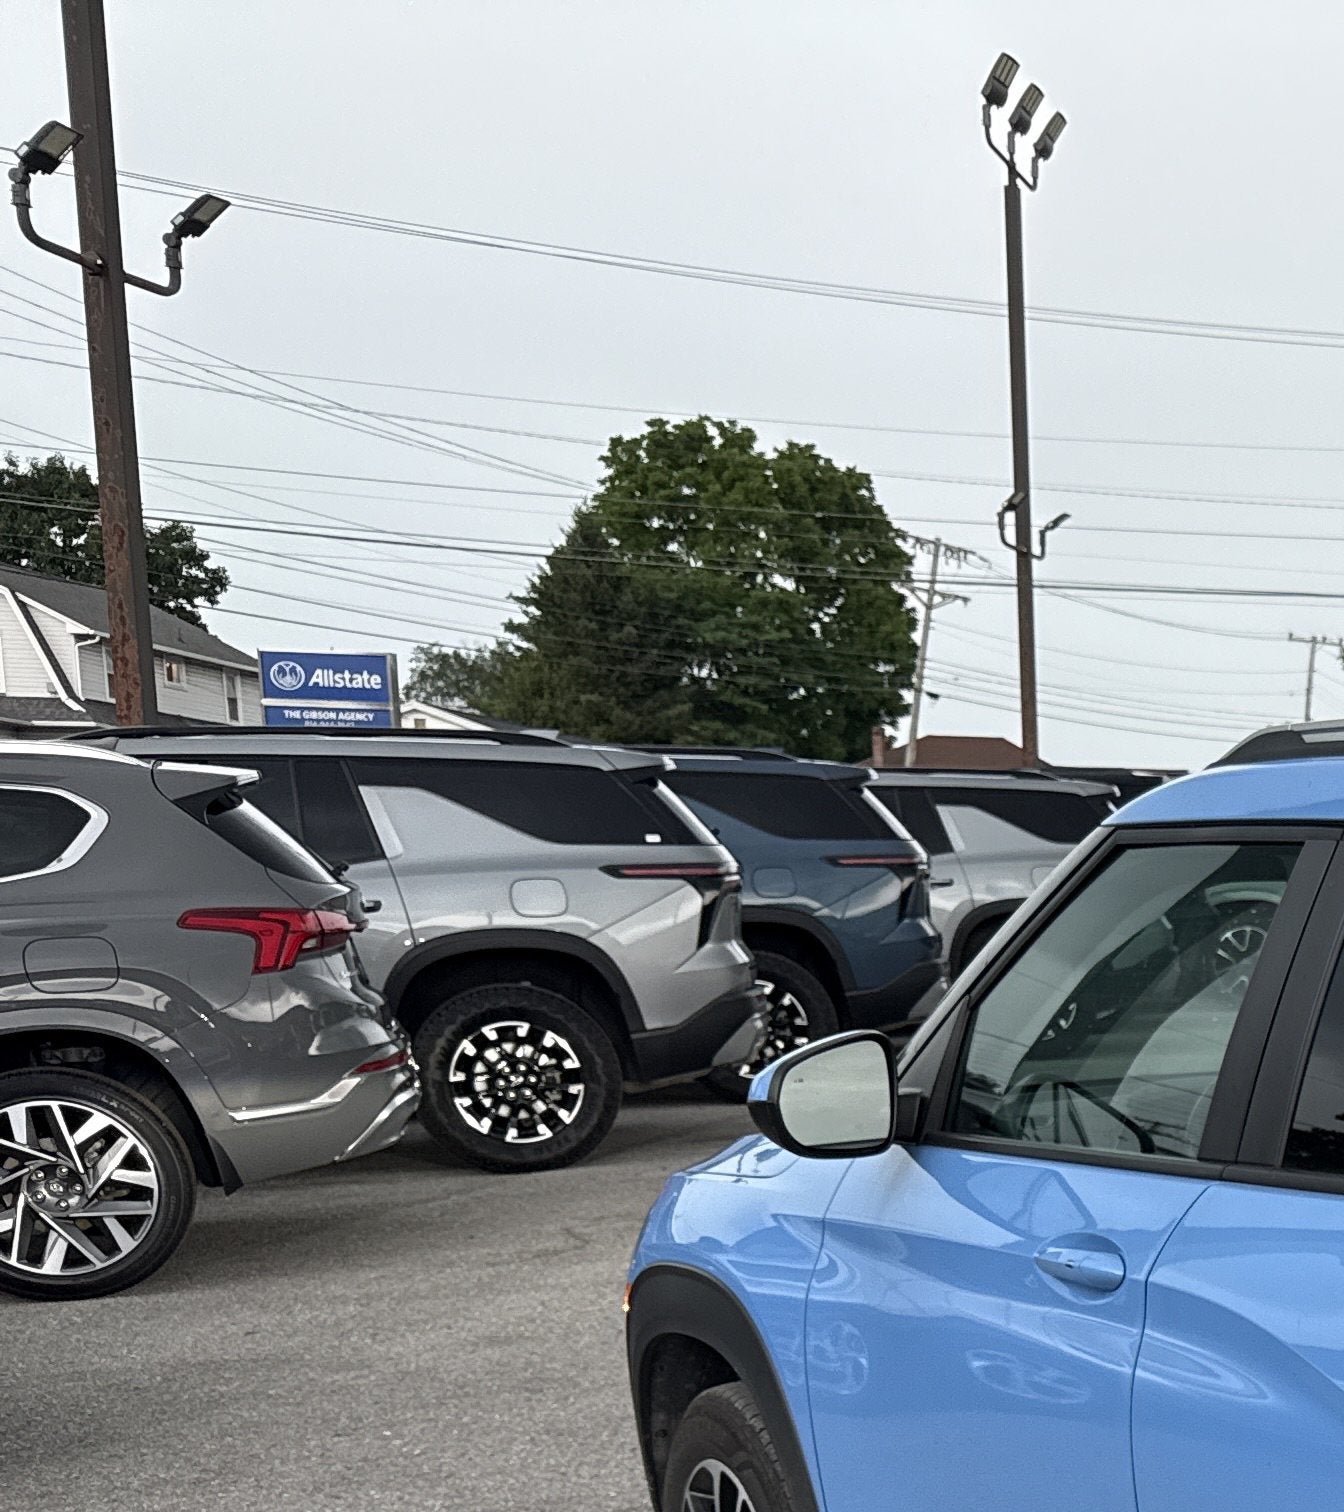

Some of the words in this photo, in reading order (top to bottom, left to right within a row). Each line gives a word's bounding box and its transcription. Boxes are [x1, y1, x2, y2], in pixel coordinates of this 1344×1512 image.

[308, 668, 382, 690] Allstate
[283, 710, 301, 720] THE
[302, 711, 337, 721] GIBSON
[338, 711, 374, 722] AGENCY
